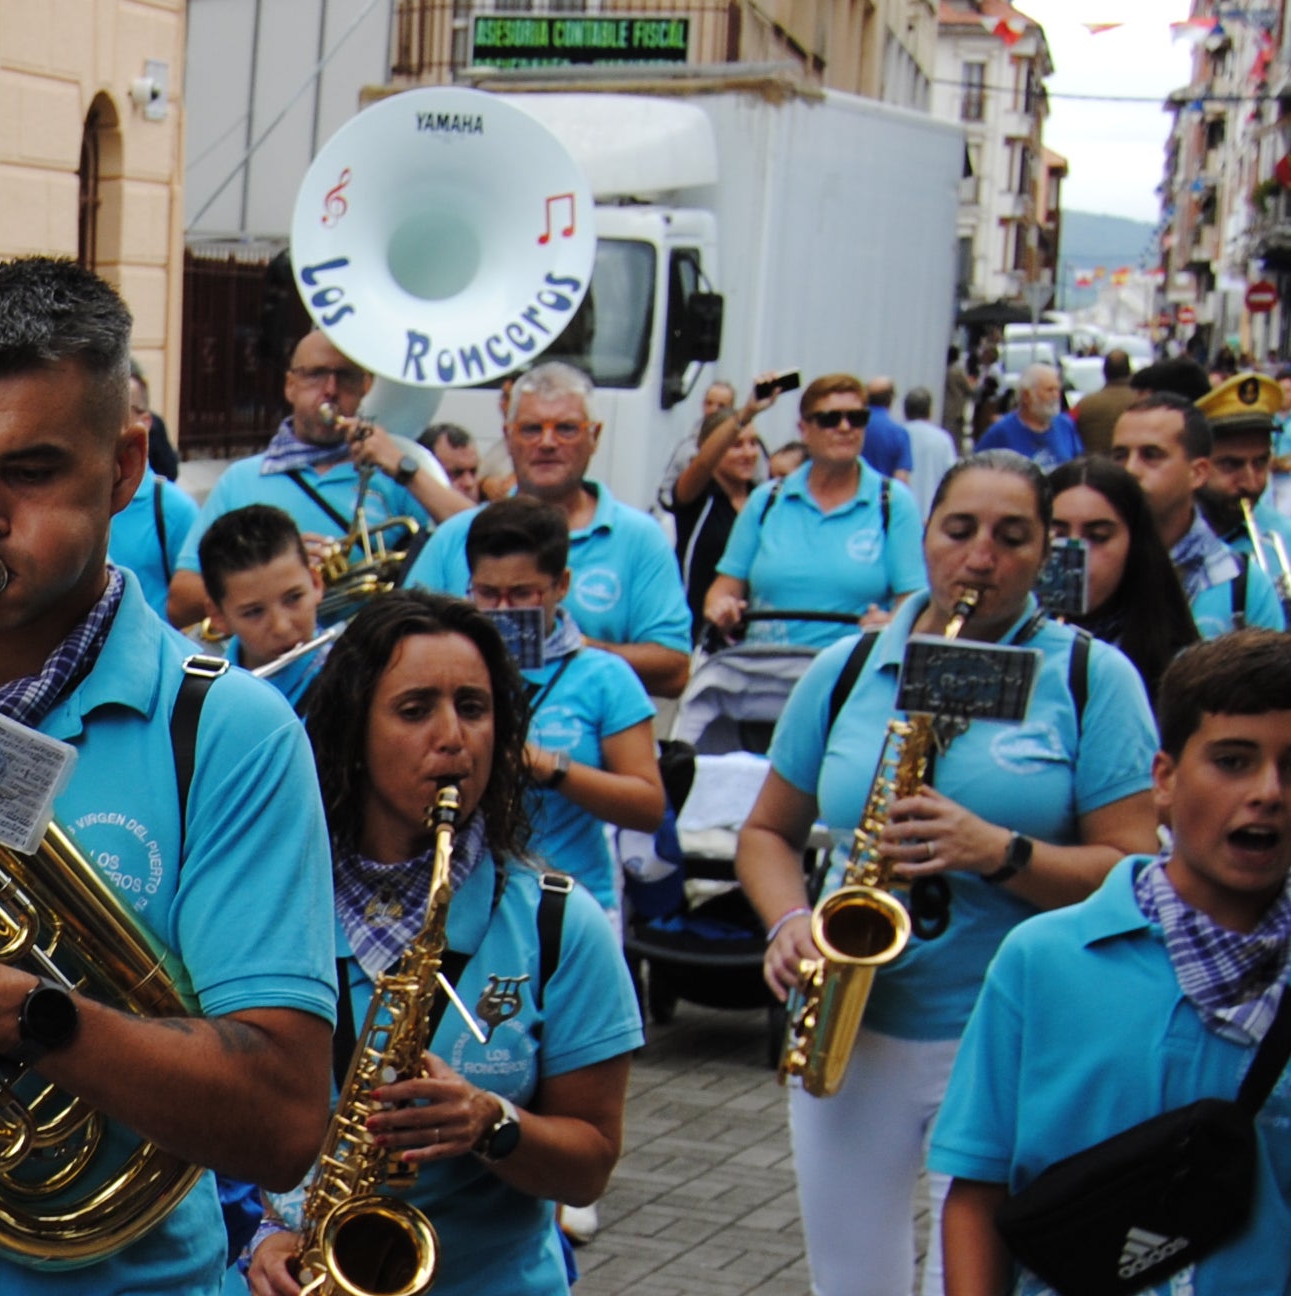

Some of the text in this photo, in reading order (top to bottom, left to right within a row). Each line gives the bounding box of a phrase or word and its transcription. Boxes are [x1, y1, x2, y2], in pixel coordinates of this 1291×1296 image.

[552, 19, 628, 48] CONTABLE
[416, 111, 485, 135] YAMAHA
[301, 256, 582, 382] Los Ronceros
[76, 812, 127, 829] VIRGEN
[125, 819, 149, 843] DEL
[145, 840, 164, 895] PUERTO
[91, 850, 120, 870] OS
[1119, 1235, 1189, 1279] adidas
